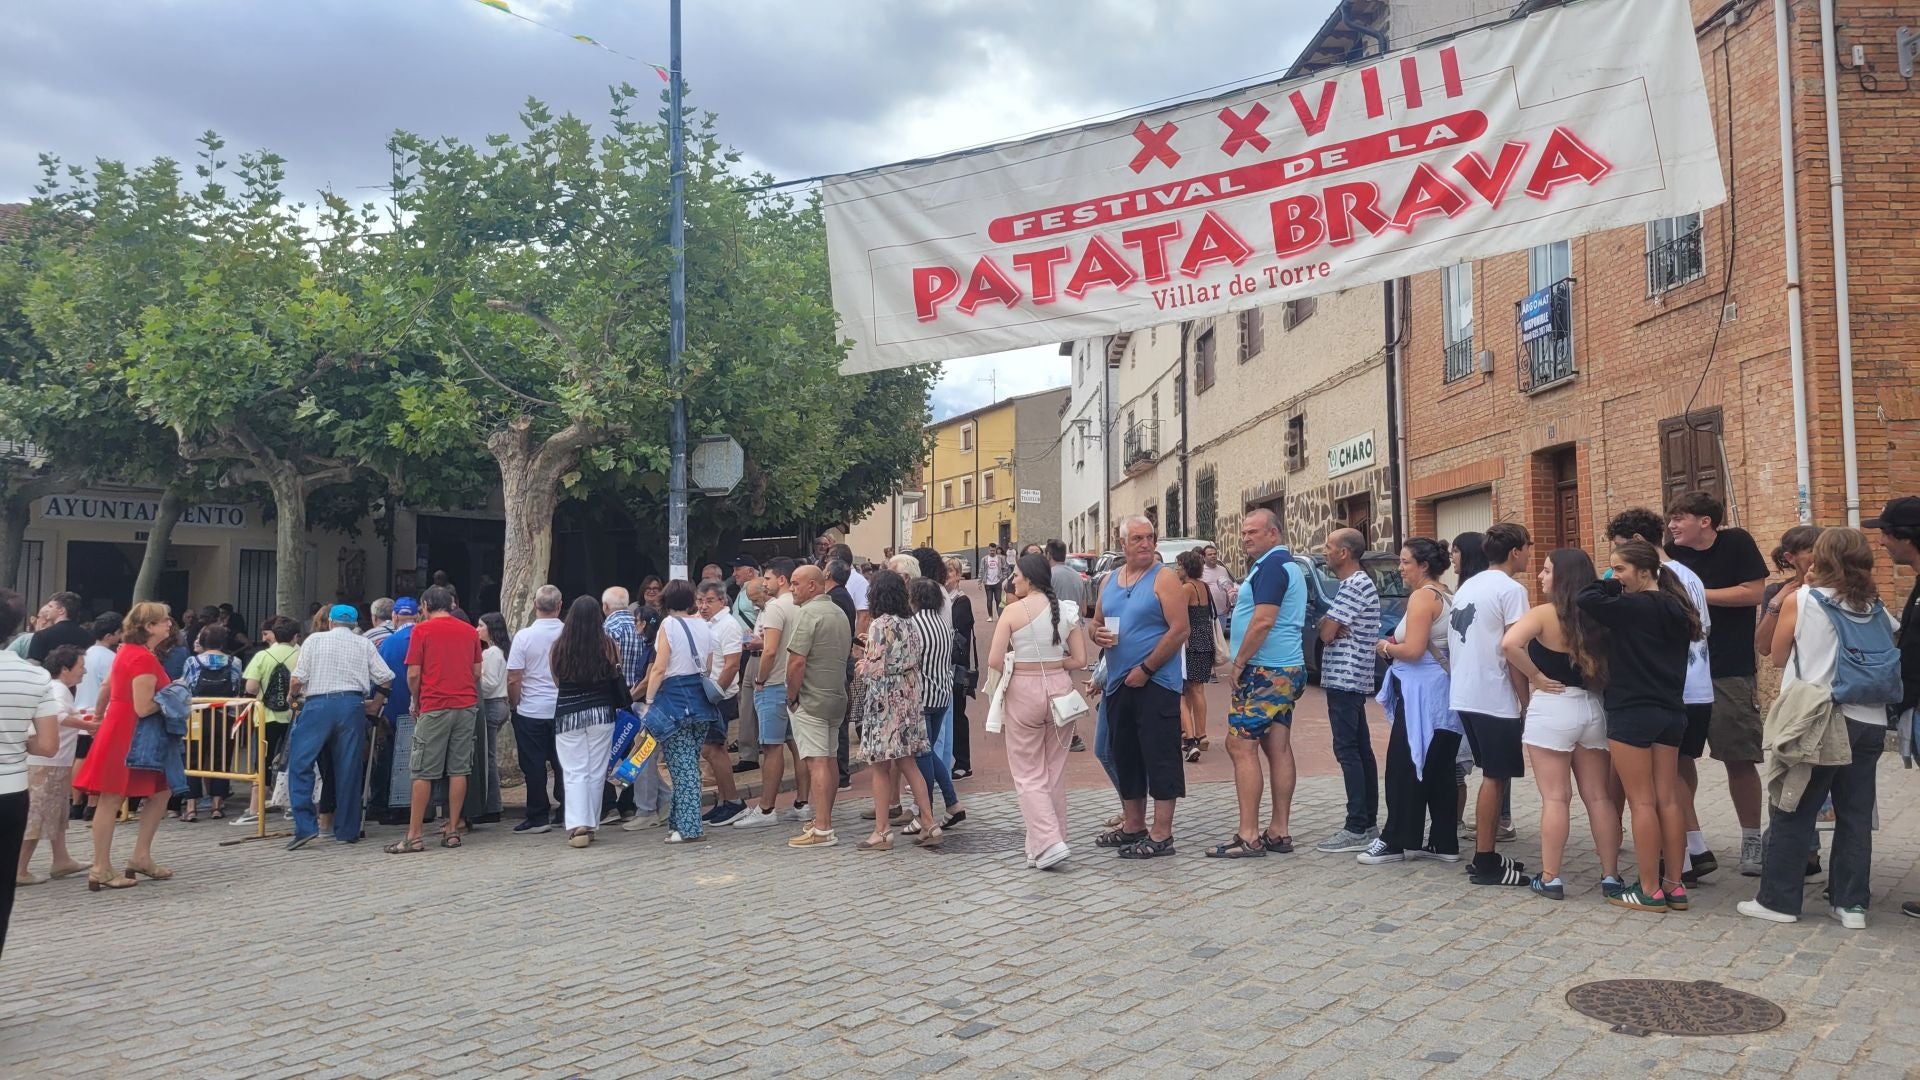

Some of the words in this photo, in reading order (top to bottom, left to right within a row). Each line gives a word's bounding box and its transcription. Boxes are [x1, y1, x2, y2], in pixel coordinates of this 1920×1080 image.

[1012, 176, 1246, 237] FESTIVAL
[1283, 147, 1349, 180] DE
[1387, 123, 1459, 153] LA
[912, 209, 1255, 323] PATATA
[1269, 126, 1614, 260] BRAVA
[1151, 283, 1221, 311] Villar
[1229, 273, 1257, 297] de
[1263, 260, 1331, 290] Torre
[1339, 438, 1373, 468] CHARO
[44, 496, 245, 527] AYUNTAENTO
